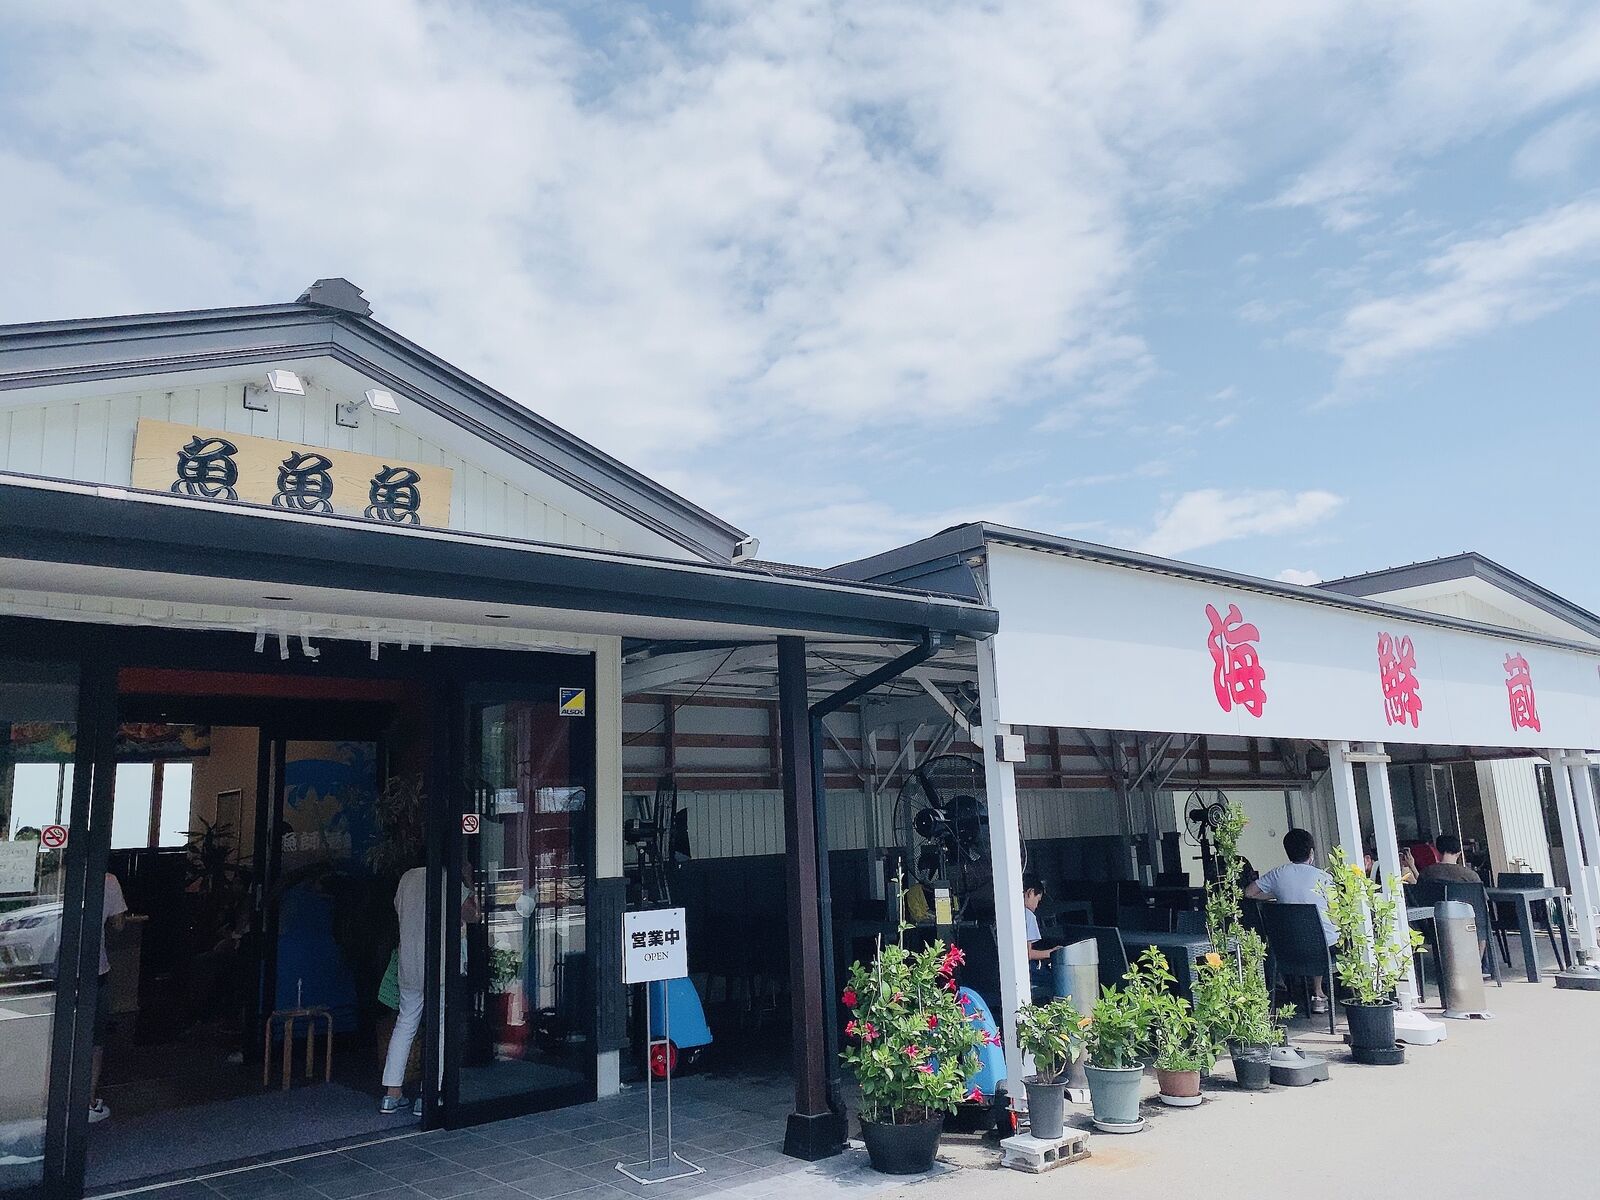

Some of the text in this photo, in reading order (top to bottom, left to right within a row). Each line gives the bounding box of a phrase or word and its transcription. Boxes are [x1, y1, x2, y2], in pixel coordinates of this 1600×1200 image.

[170, 435, 421, 525] 魚魚魚
[1204, 603, 1541, 733] 海鮮蔵
[631, 928, 680, 949] 営業中
[644, 951, 669, 961] OPEN
